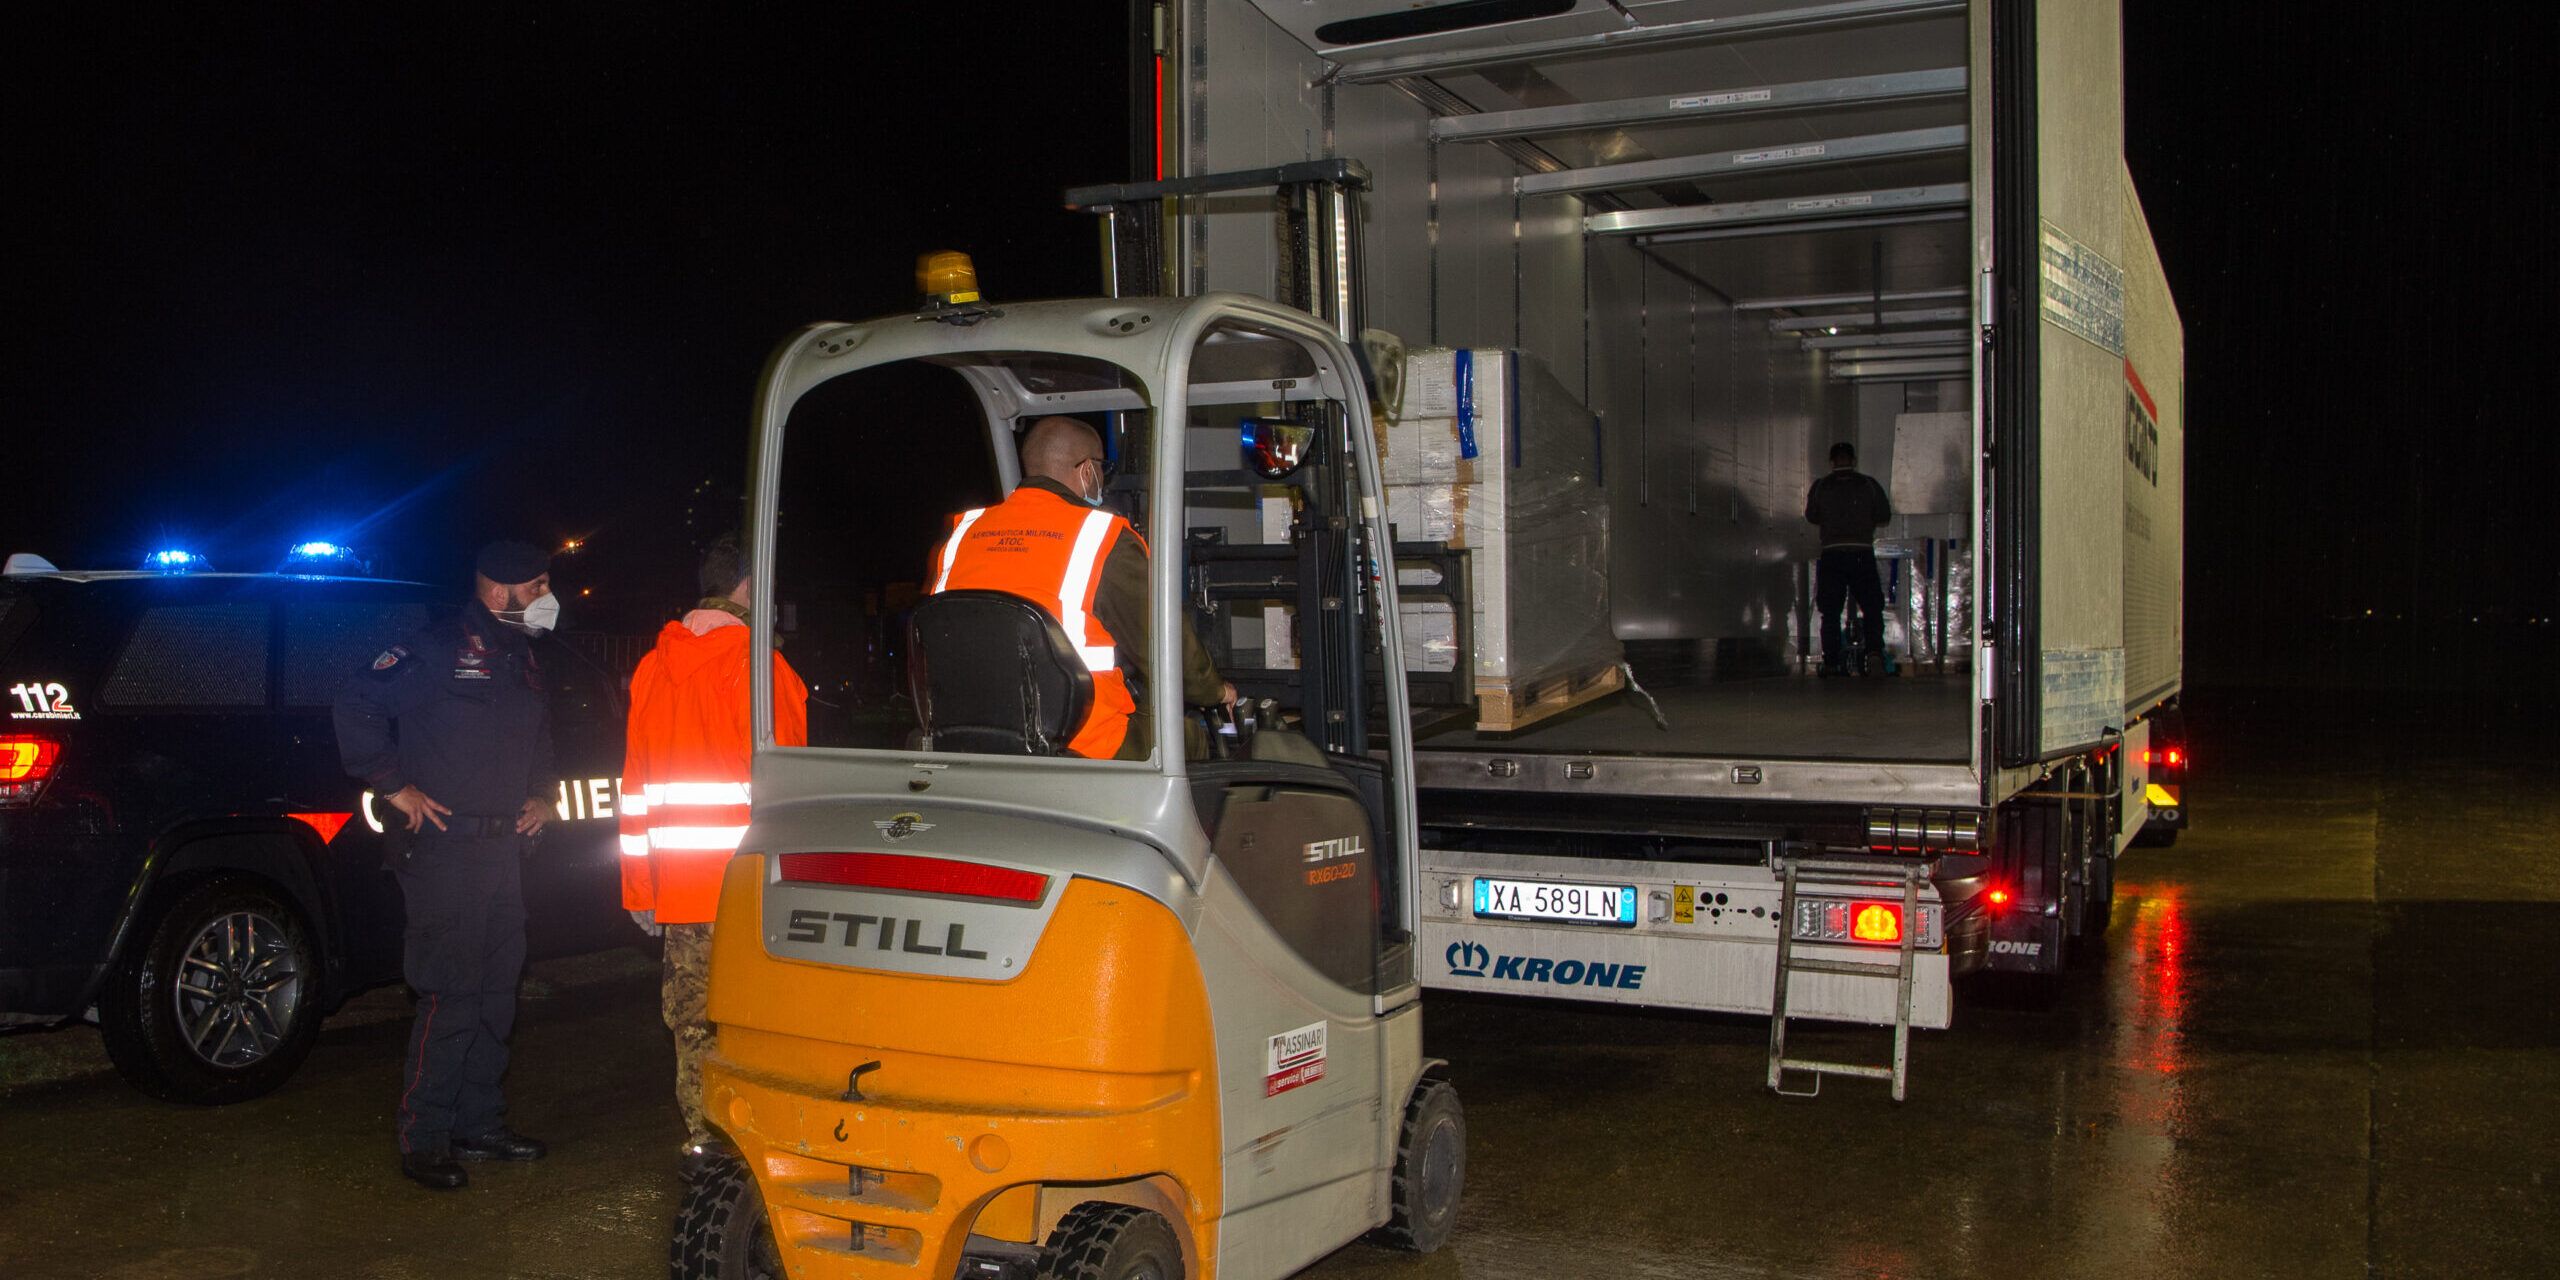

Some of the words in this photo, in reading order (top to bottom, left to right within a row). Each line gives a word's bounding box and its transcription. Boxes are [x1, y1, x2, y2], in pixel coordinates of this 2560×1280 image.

[998, 537, 1024, 546] ATOC
[1025, 529, 1065, 540] MILITARE
[10, 682, 74, 712] 112
[10, 712, 82, 720] www.carabinieri.it
[555, 778, 623, 821] NIE
[1302, 835, 1365, 863] STILL
[1494, 885, 1522, 912] XA
[1535, 887, 1616, 918] 589LN
[787, 909, 988, 960] STILL
[1492, 955, 1647, 990] KRONE
